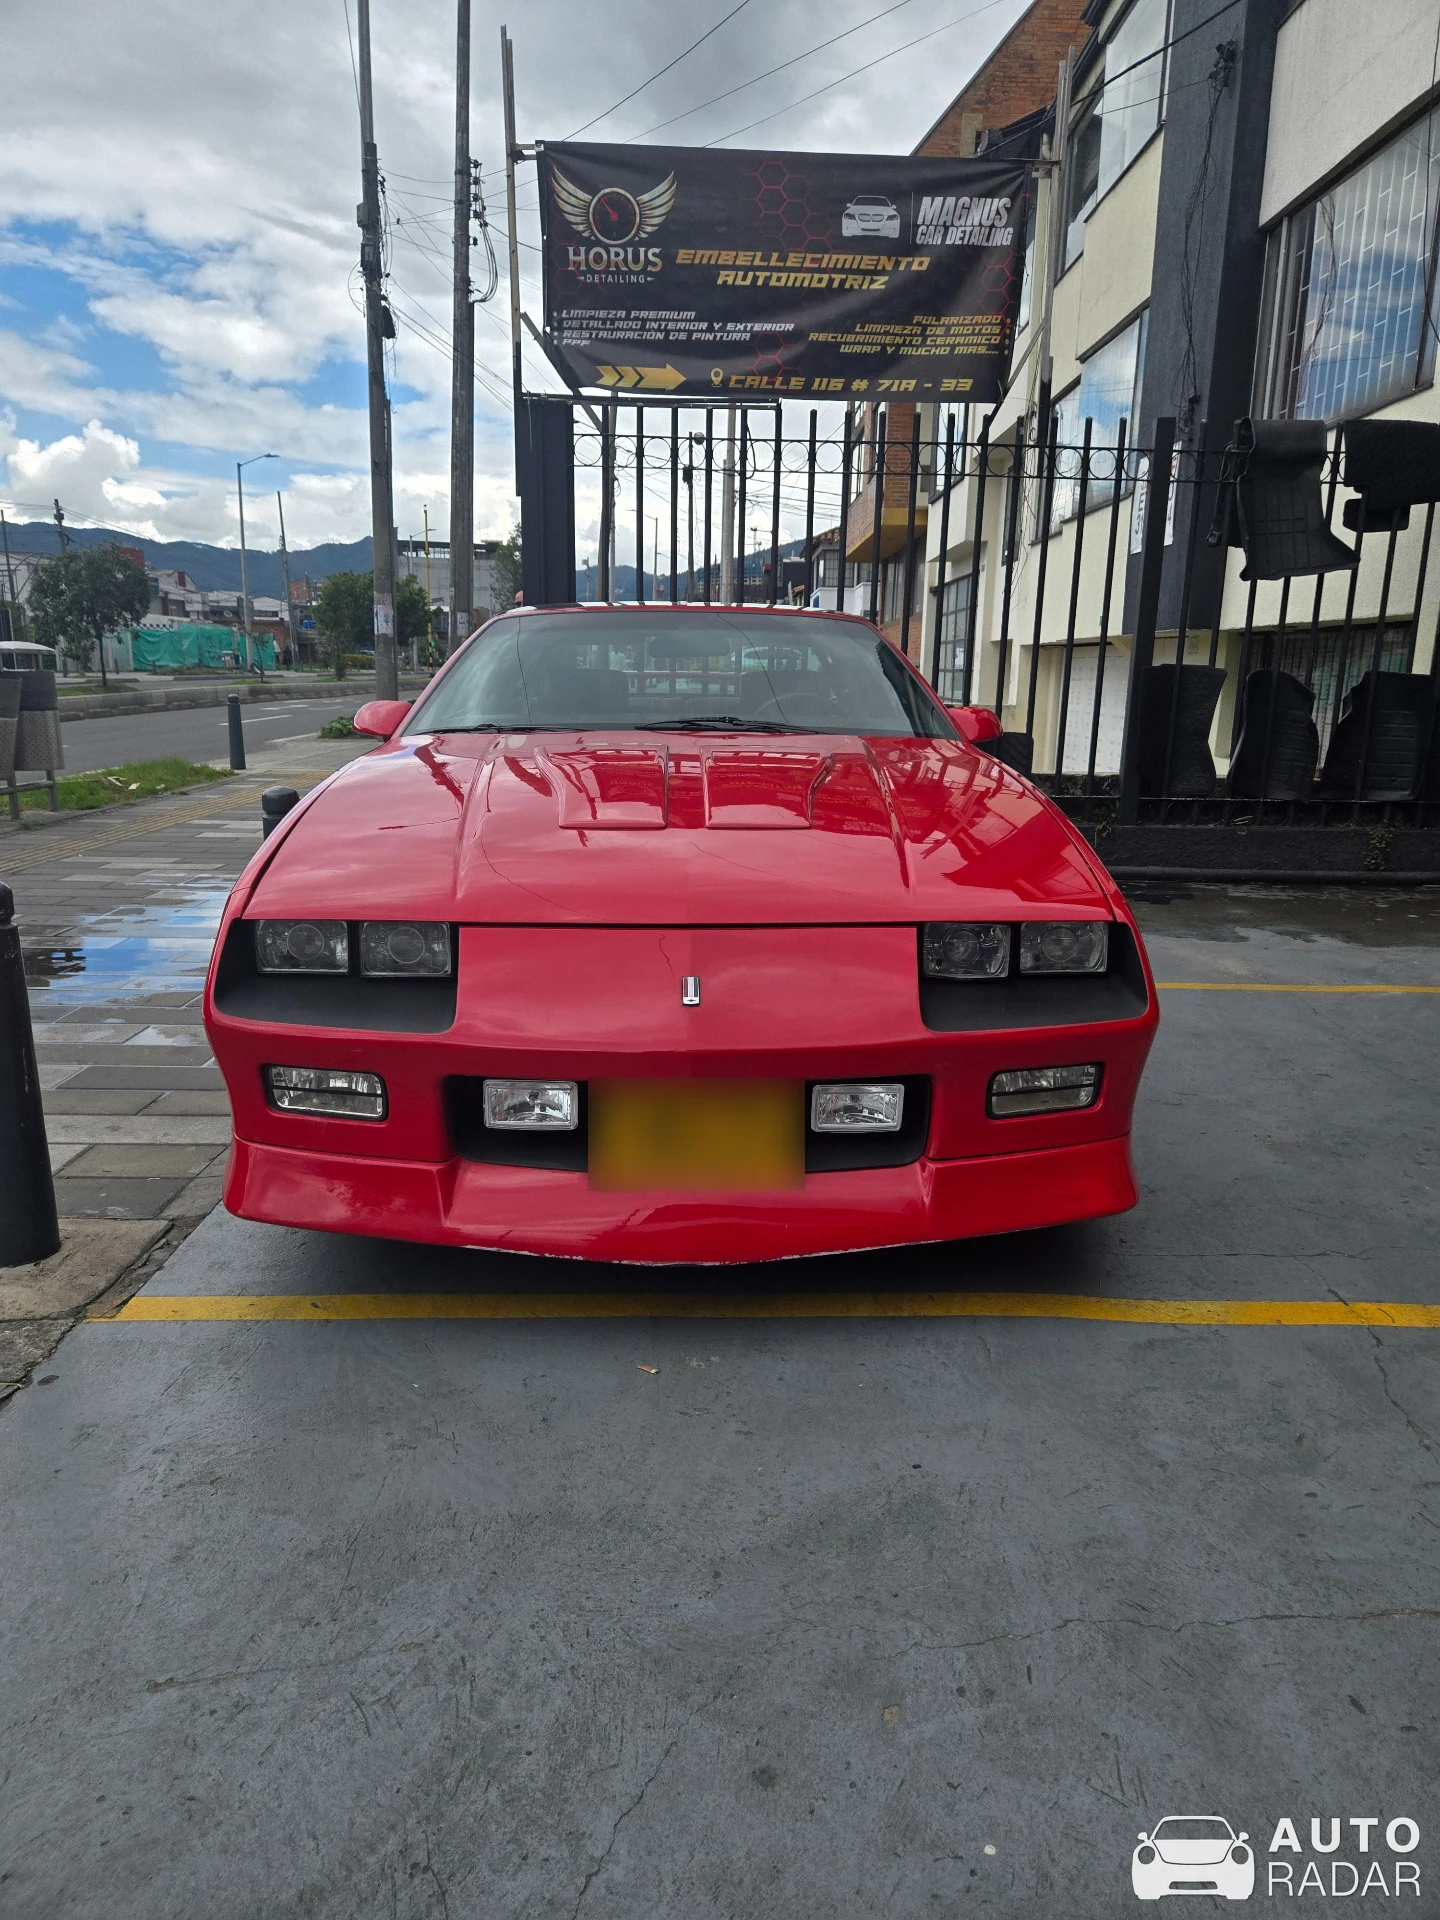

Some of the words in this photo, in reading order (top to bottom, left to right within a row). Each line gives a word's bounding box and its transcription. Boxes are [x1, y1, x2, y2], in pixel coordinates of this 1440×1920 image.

[917, 196, 1011, 227] MAGNUS
[915, 225, 945, 245] CAR
[945, 226, 1014, 247] DETAILING
[566, 246, 663, 273] HORUS
[675, 249, 931, 271] EMBELLECIMIENTO
[586, 274, 646, 284] DETAILING
[716, 270, 889, 290] AUTOMOTRIZ
[561, 309, 627, 319] LIMPIEZA
[629, 310, 696, 320] PREMIUM
[912, 315, 1002, 325] POLARIZADO
[562, 320, 642, 329] DETALLADO
[645, 320, 709, 331] INTERIOR
[713, 321, 723, 331] Y
[726, 322, 795, 331] EXTERIOR
[854, 323, 922, 334] LIMPIEZA
[926, 325, 945, 335] DE
[949, 325, 1002, 334] MOTOS
[562, 329, 666, 340] RESTAURACIÓN
[668, 331, 688, 340] DE
[691, 332, 752, 341] PINTURA
[808, 332, 923, 345] RECUBRIMIENTO
[925, 335, 1002, 345] CERAMICO
[561, 338, 591, 347] PPF
[839, 344, 881, 354] WRAP
[886, 345, 896, 354] Y
[898, 345, 950, 355] MUCHO
[728, 375, 806, 390] CALLE
[810, 377, 846, 392] 116
[850, 378, 870, 392] #
[875, 379, 918, 392] 71A
[939, 378, 974, 392] 33
